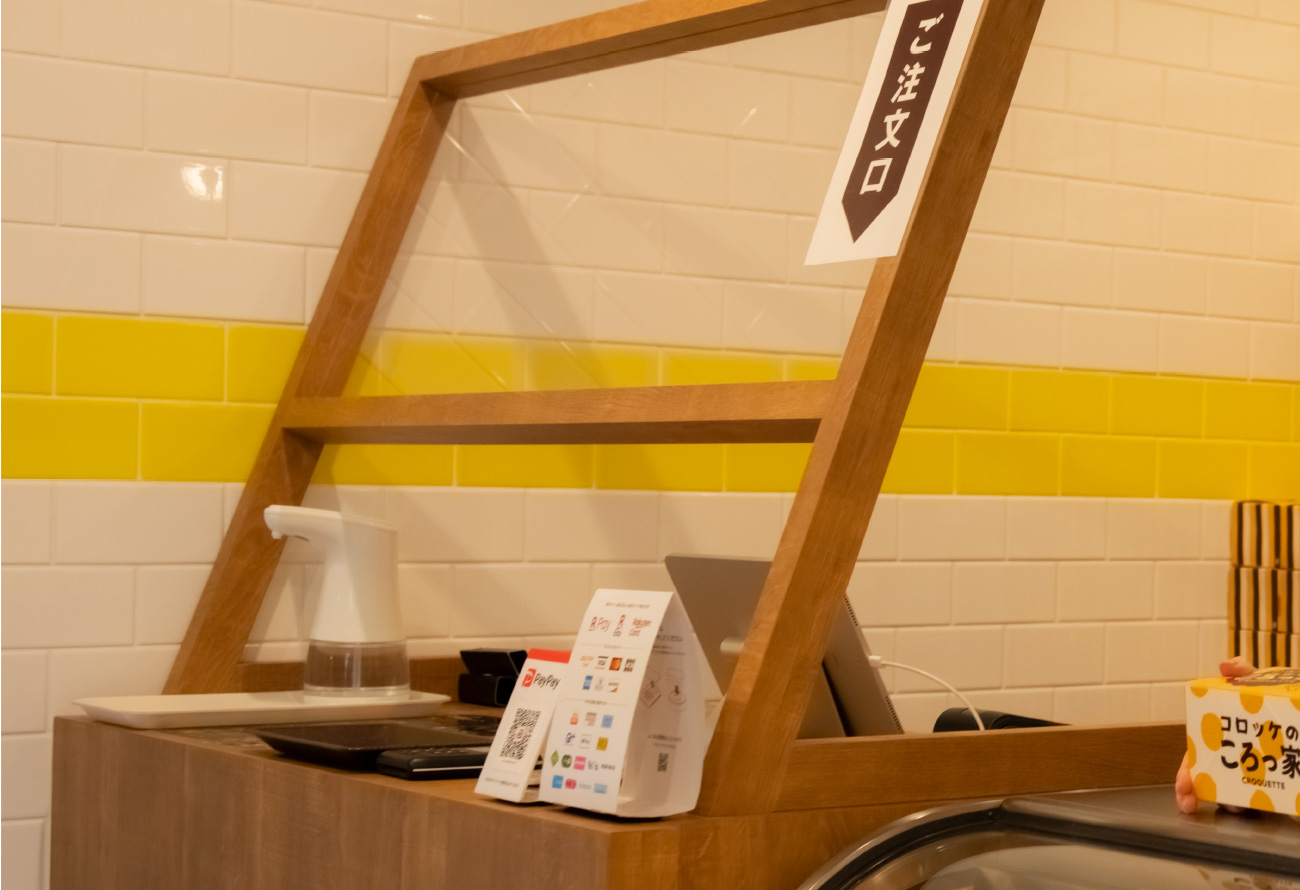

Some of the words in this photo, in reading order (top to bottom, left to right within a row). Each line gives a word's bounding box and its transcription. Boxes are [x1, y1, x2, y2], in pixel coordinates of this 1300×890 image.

[859, 13, 944, 195] ご注文口
[533, 672, 561, 690] PayPay
[1220, 715, 1299, 741] コロッケの
[1241, 776, 1286, 790] CROQUETTE
